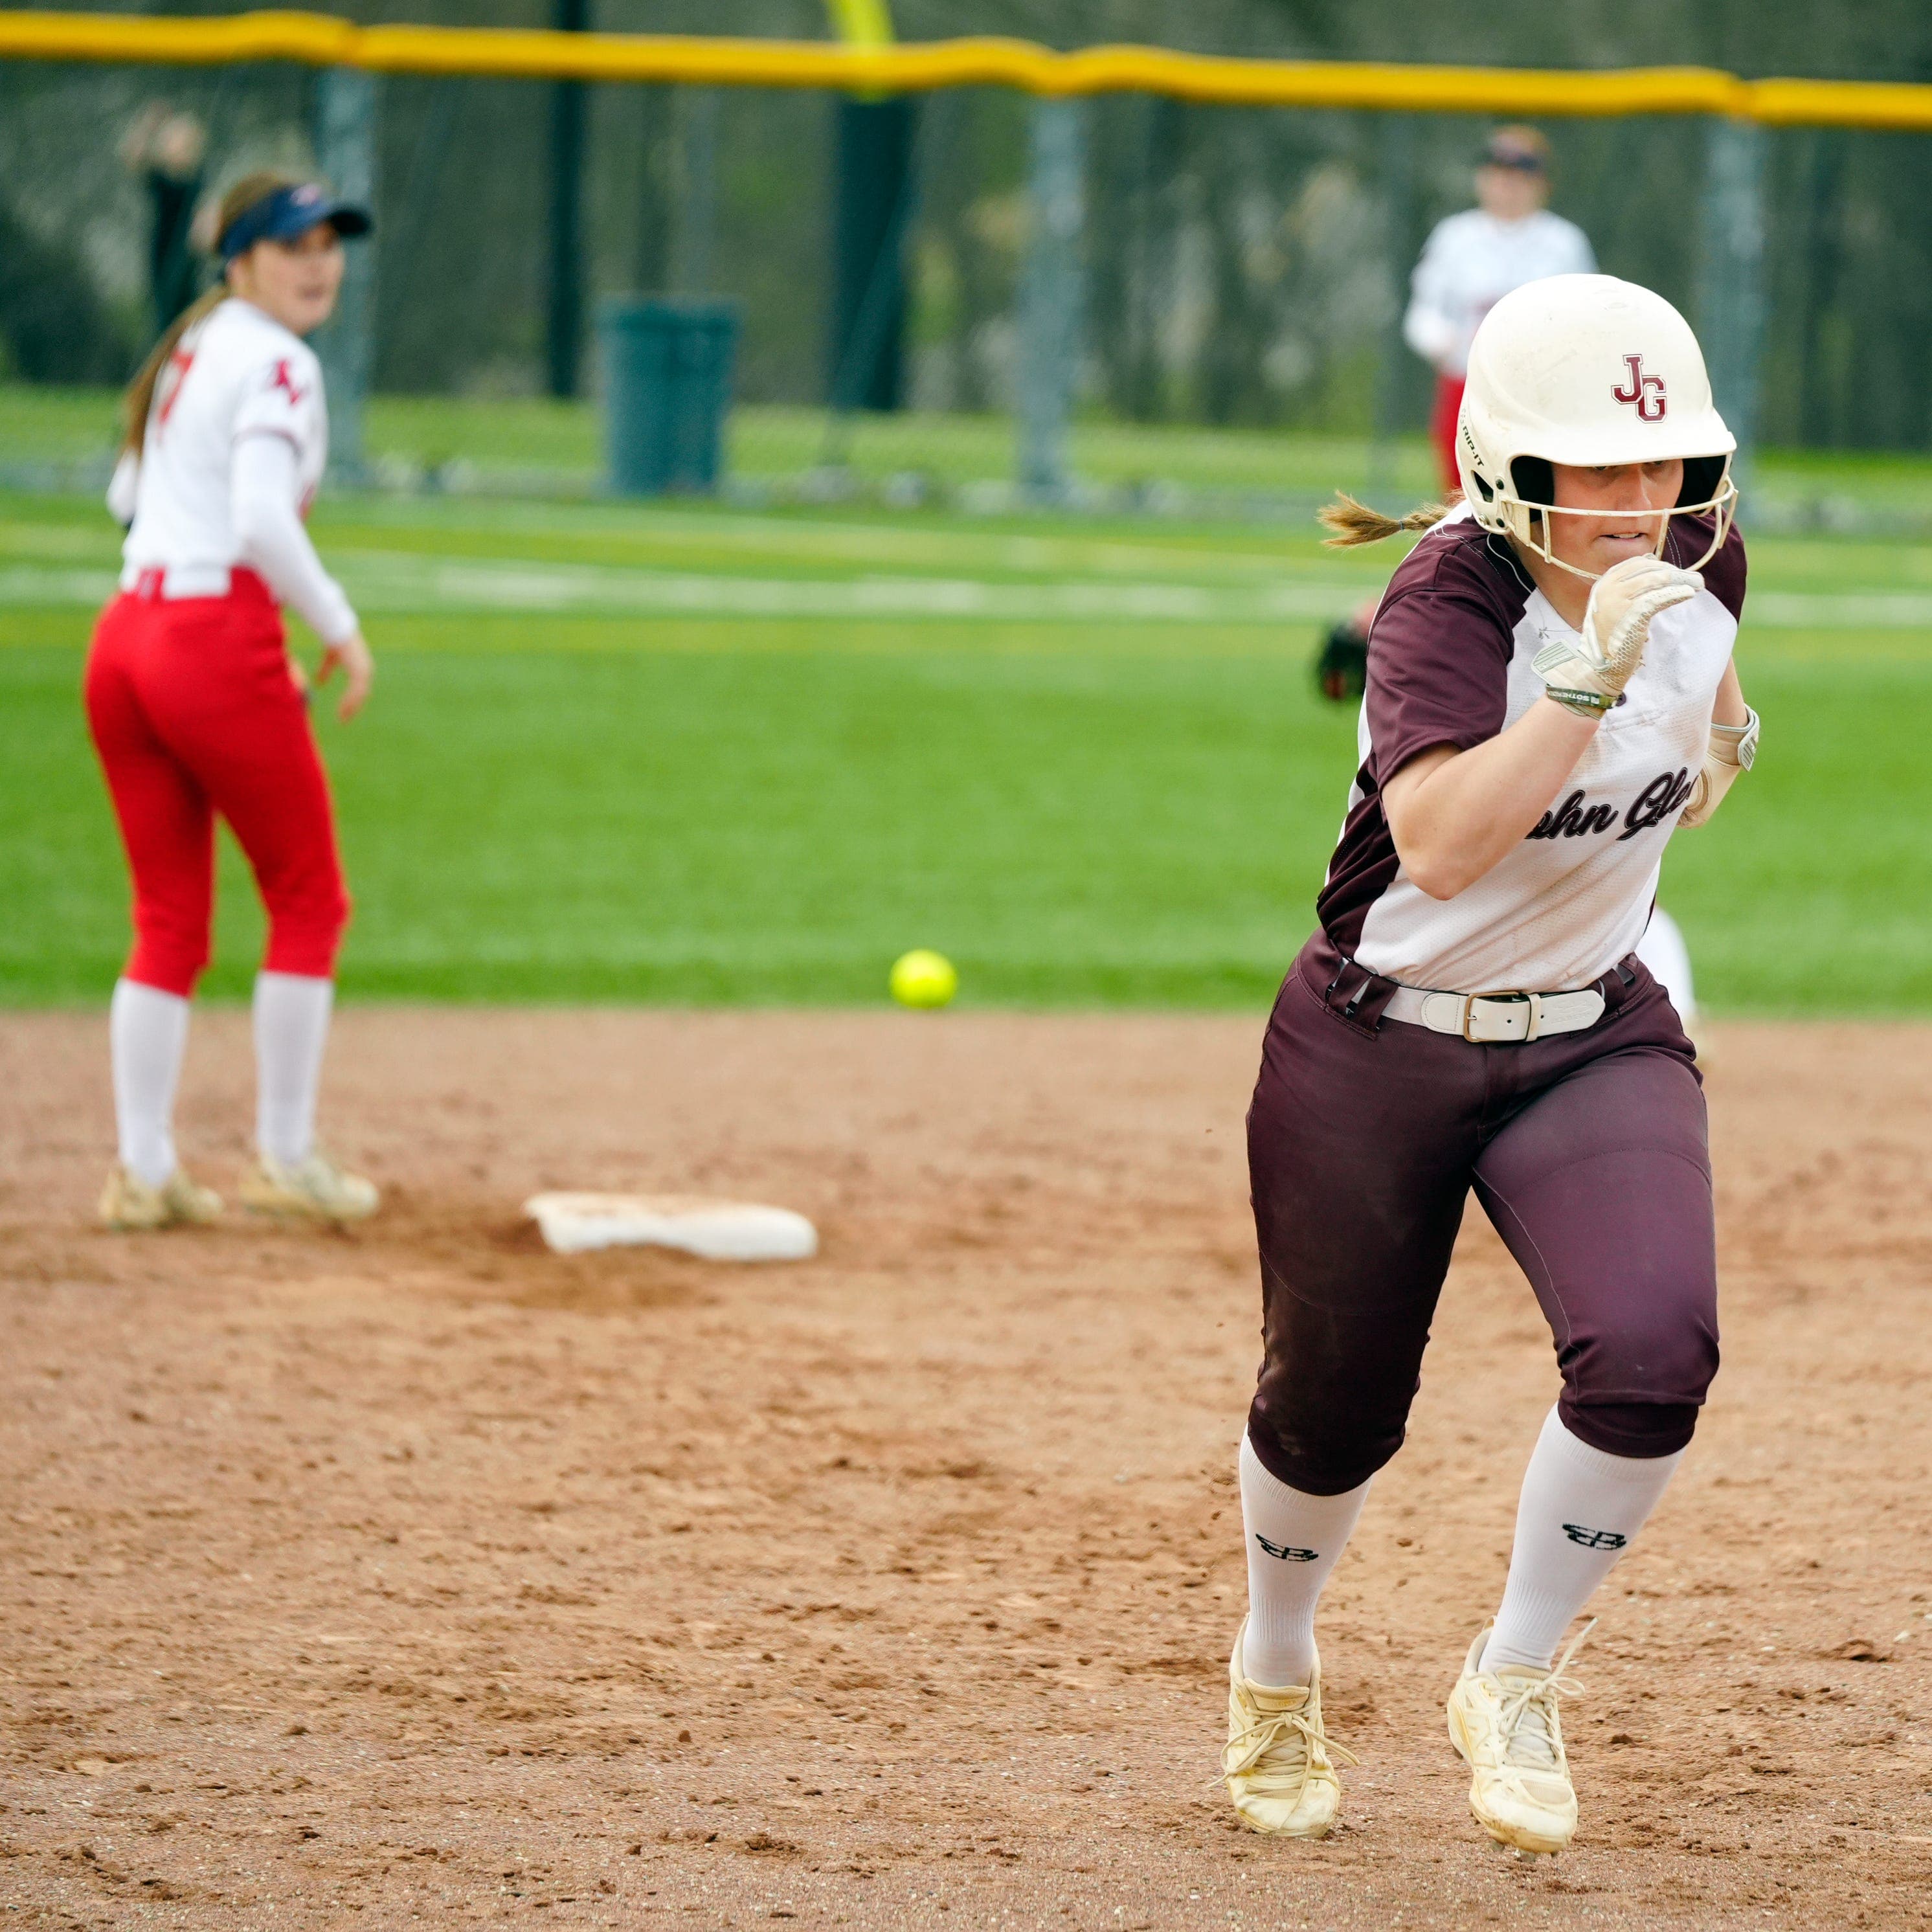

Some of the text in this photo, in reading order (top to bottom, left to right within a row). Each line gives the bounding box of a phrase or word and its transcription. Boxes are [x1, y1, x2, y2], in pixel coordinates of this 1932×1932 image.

[1611, 354, 1668, 423] JG
[1463, 425, 1485, 466] RIP-IT
[1524, 767, 1699, 840] ohn Gle
